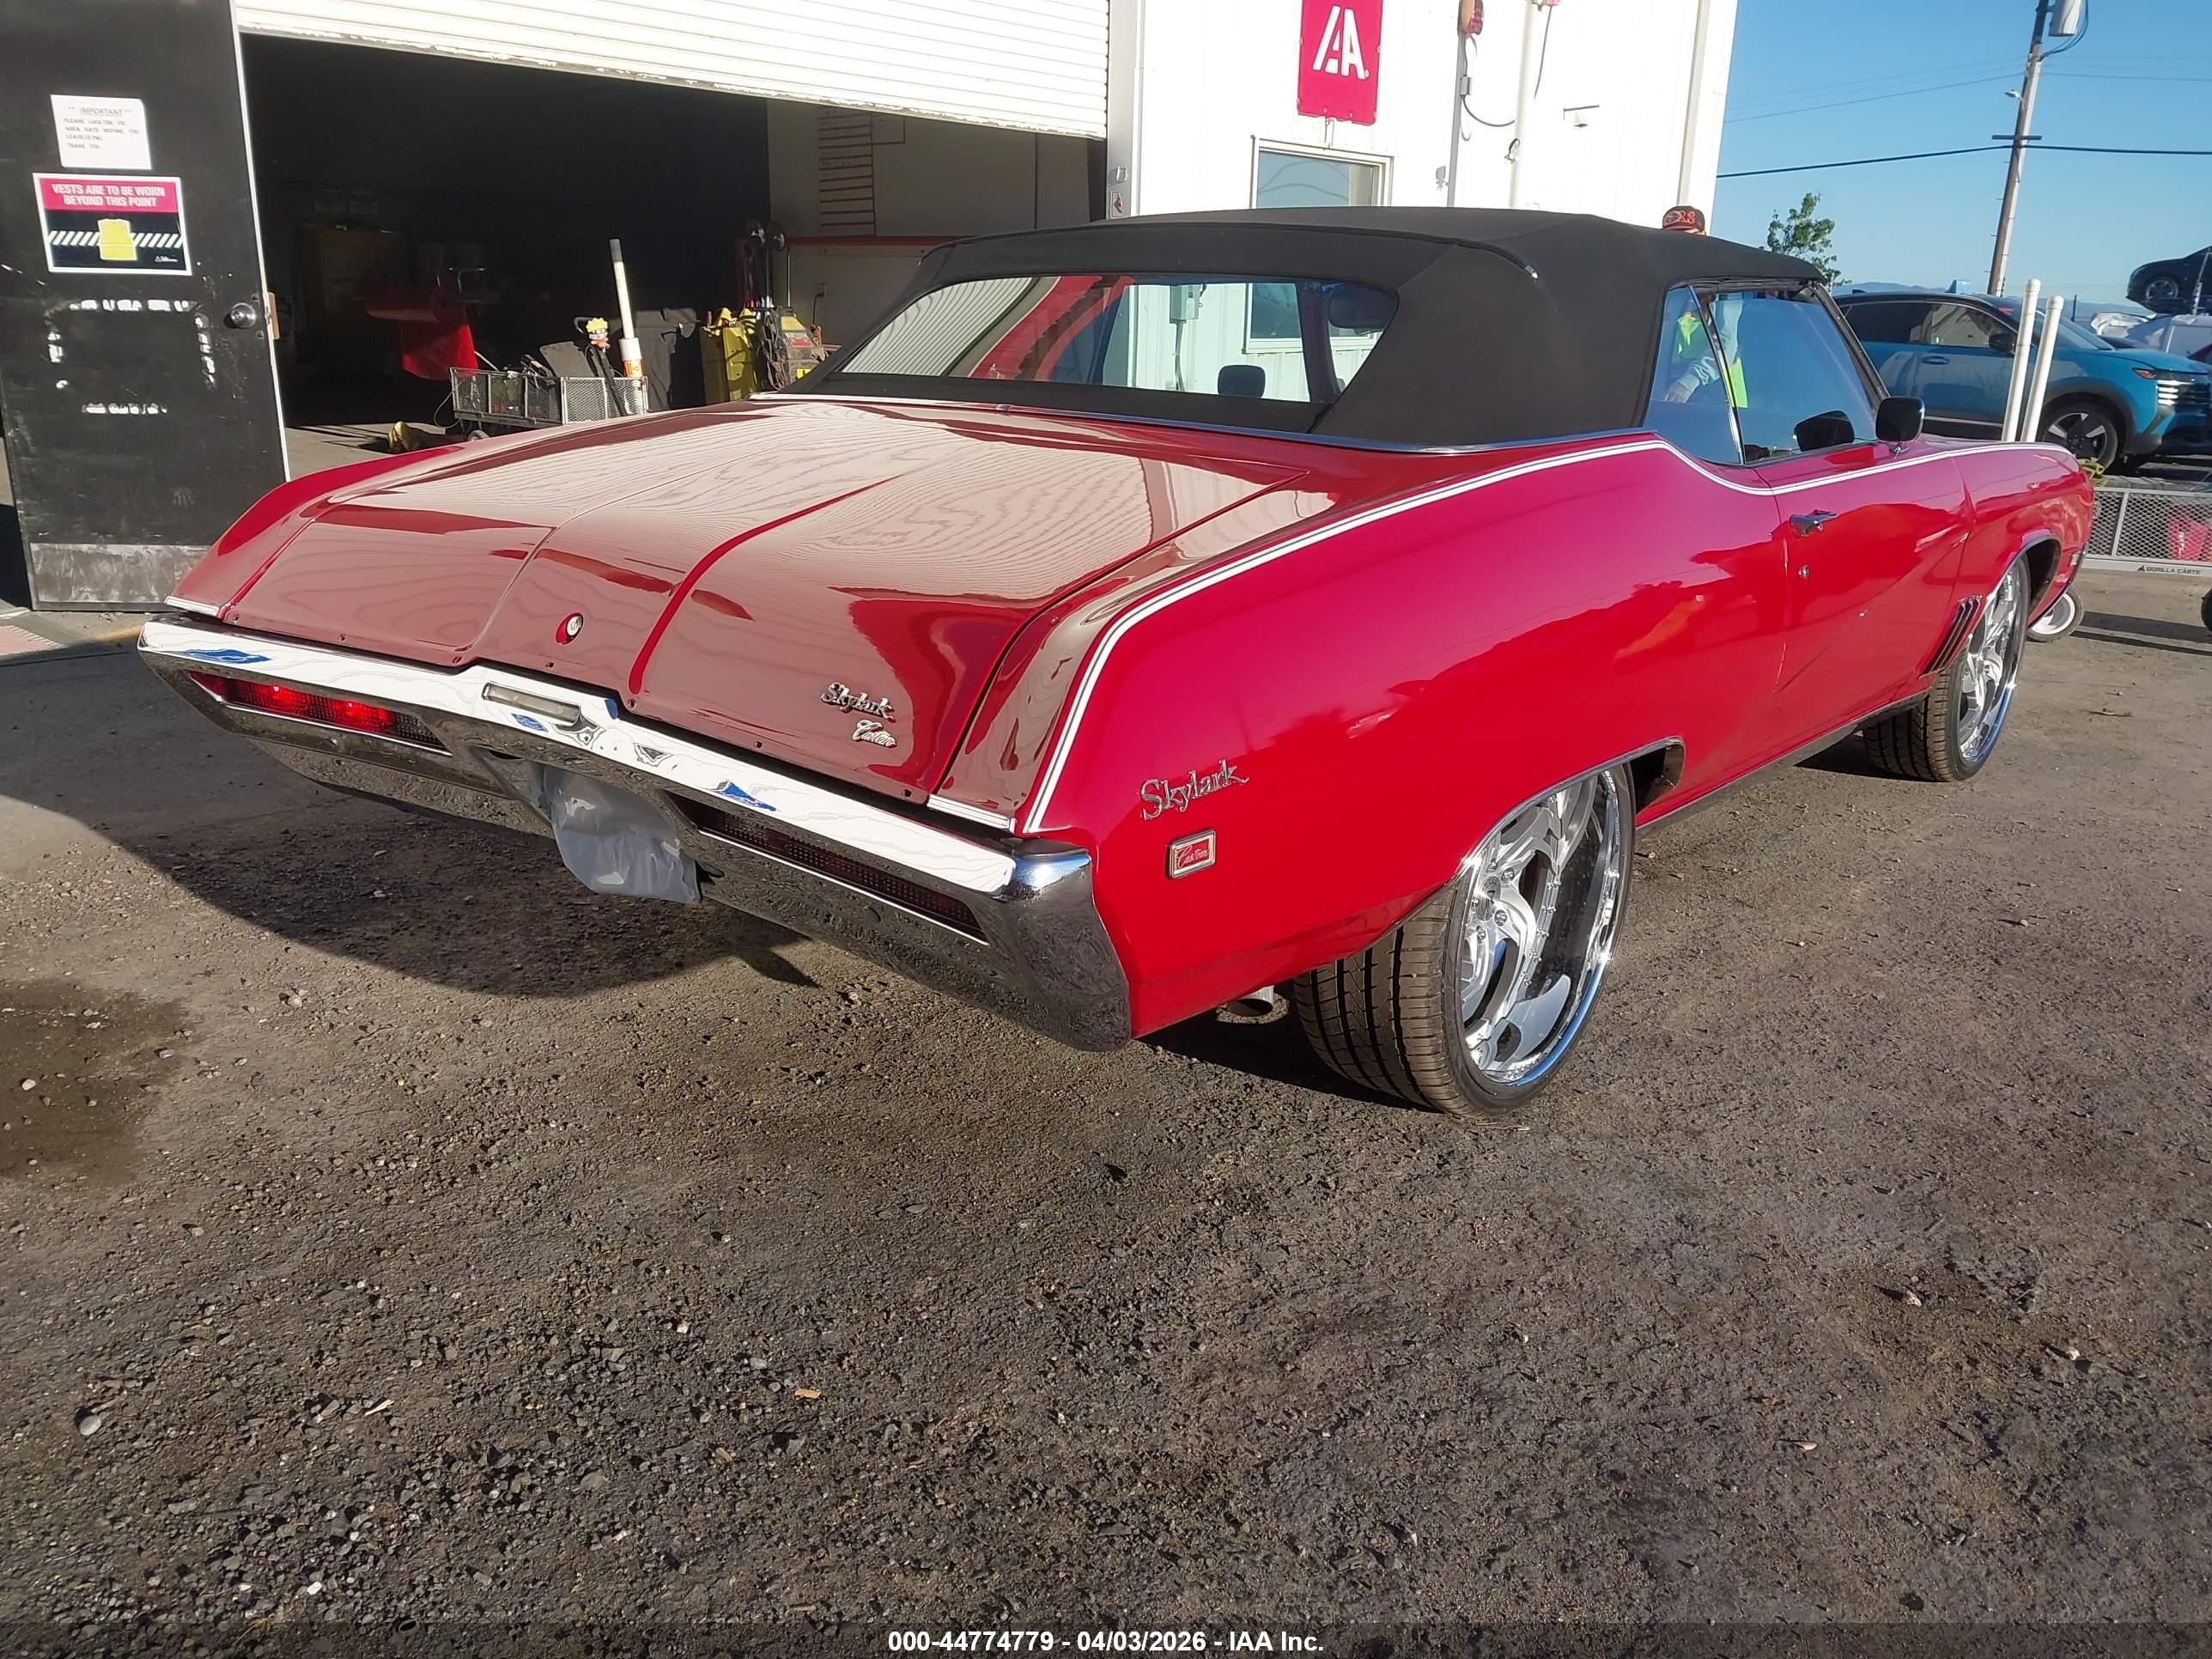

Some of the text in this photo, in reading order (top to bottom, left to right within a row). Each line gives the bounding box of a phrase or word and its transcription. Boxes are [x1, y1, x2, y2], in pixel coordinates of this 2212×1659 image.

[52, 183, 166, 197] VESTS ARE TO BE WORN
[64, 195, 157, 207] BEYOND THIS POINT
[821, 681, 896, 723] Skylark
[1140, 758, 1250, 821] Skylark
[1176, 843, 1209, 868] Custom
